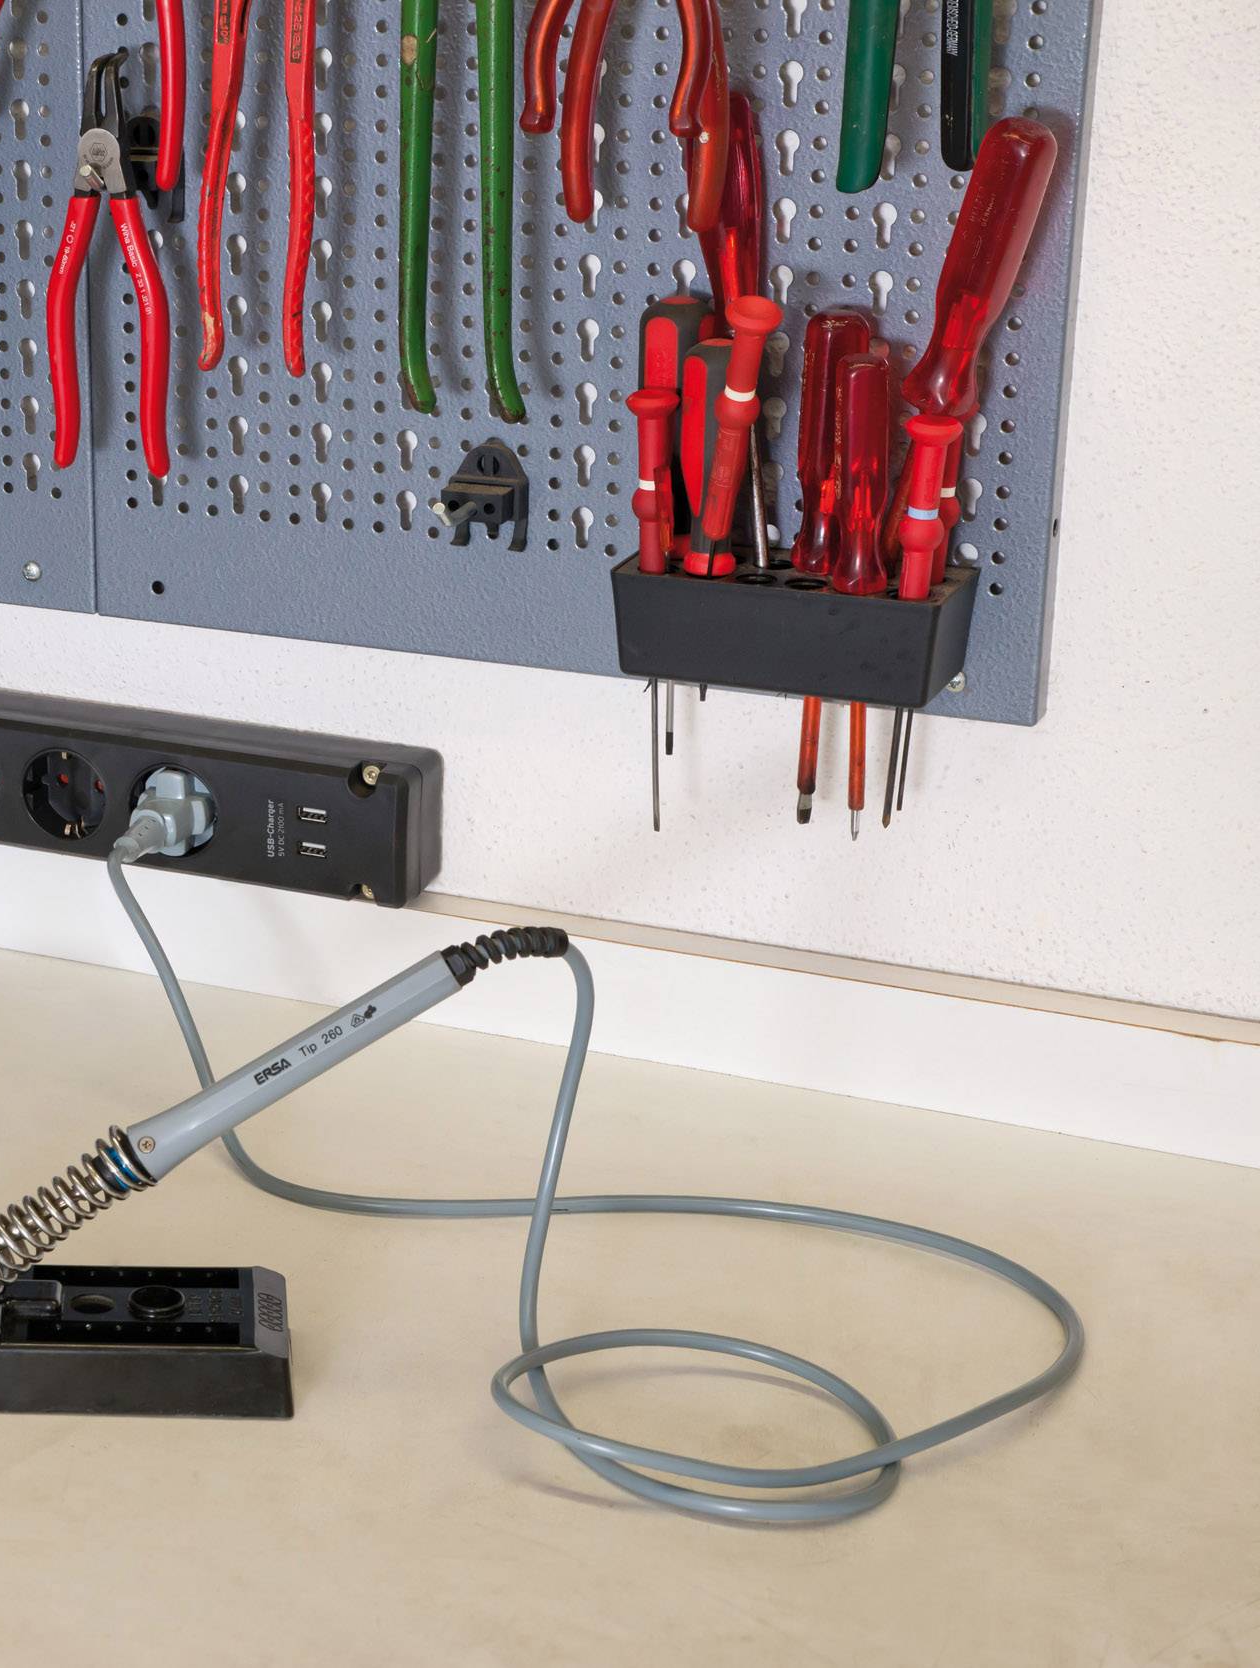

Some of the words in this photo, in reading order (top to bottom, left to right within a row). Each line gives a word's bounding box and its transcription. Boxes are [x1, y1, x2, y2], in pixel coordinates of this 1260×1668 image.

[267, 799, 276, 858] USB-Charger
[277, 834, 285, 845] DC
[277, 846, 285, 857] 5V
[253, 1057, 292, 1086] ERSA
[298, 1042, 318, 1057] Tip
[321, 1025, 344, 1045] 260
